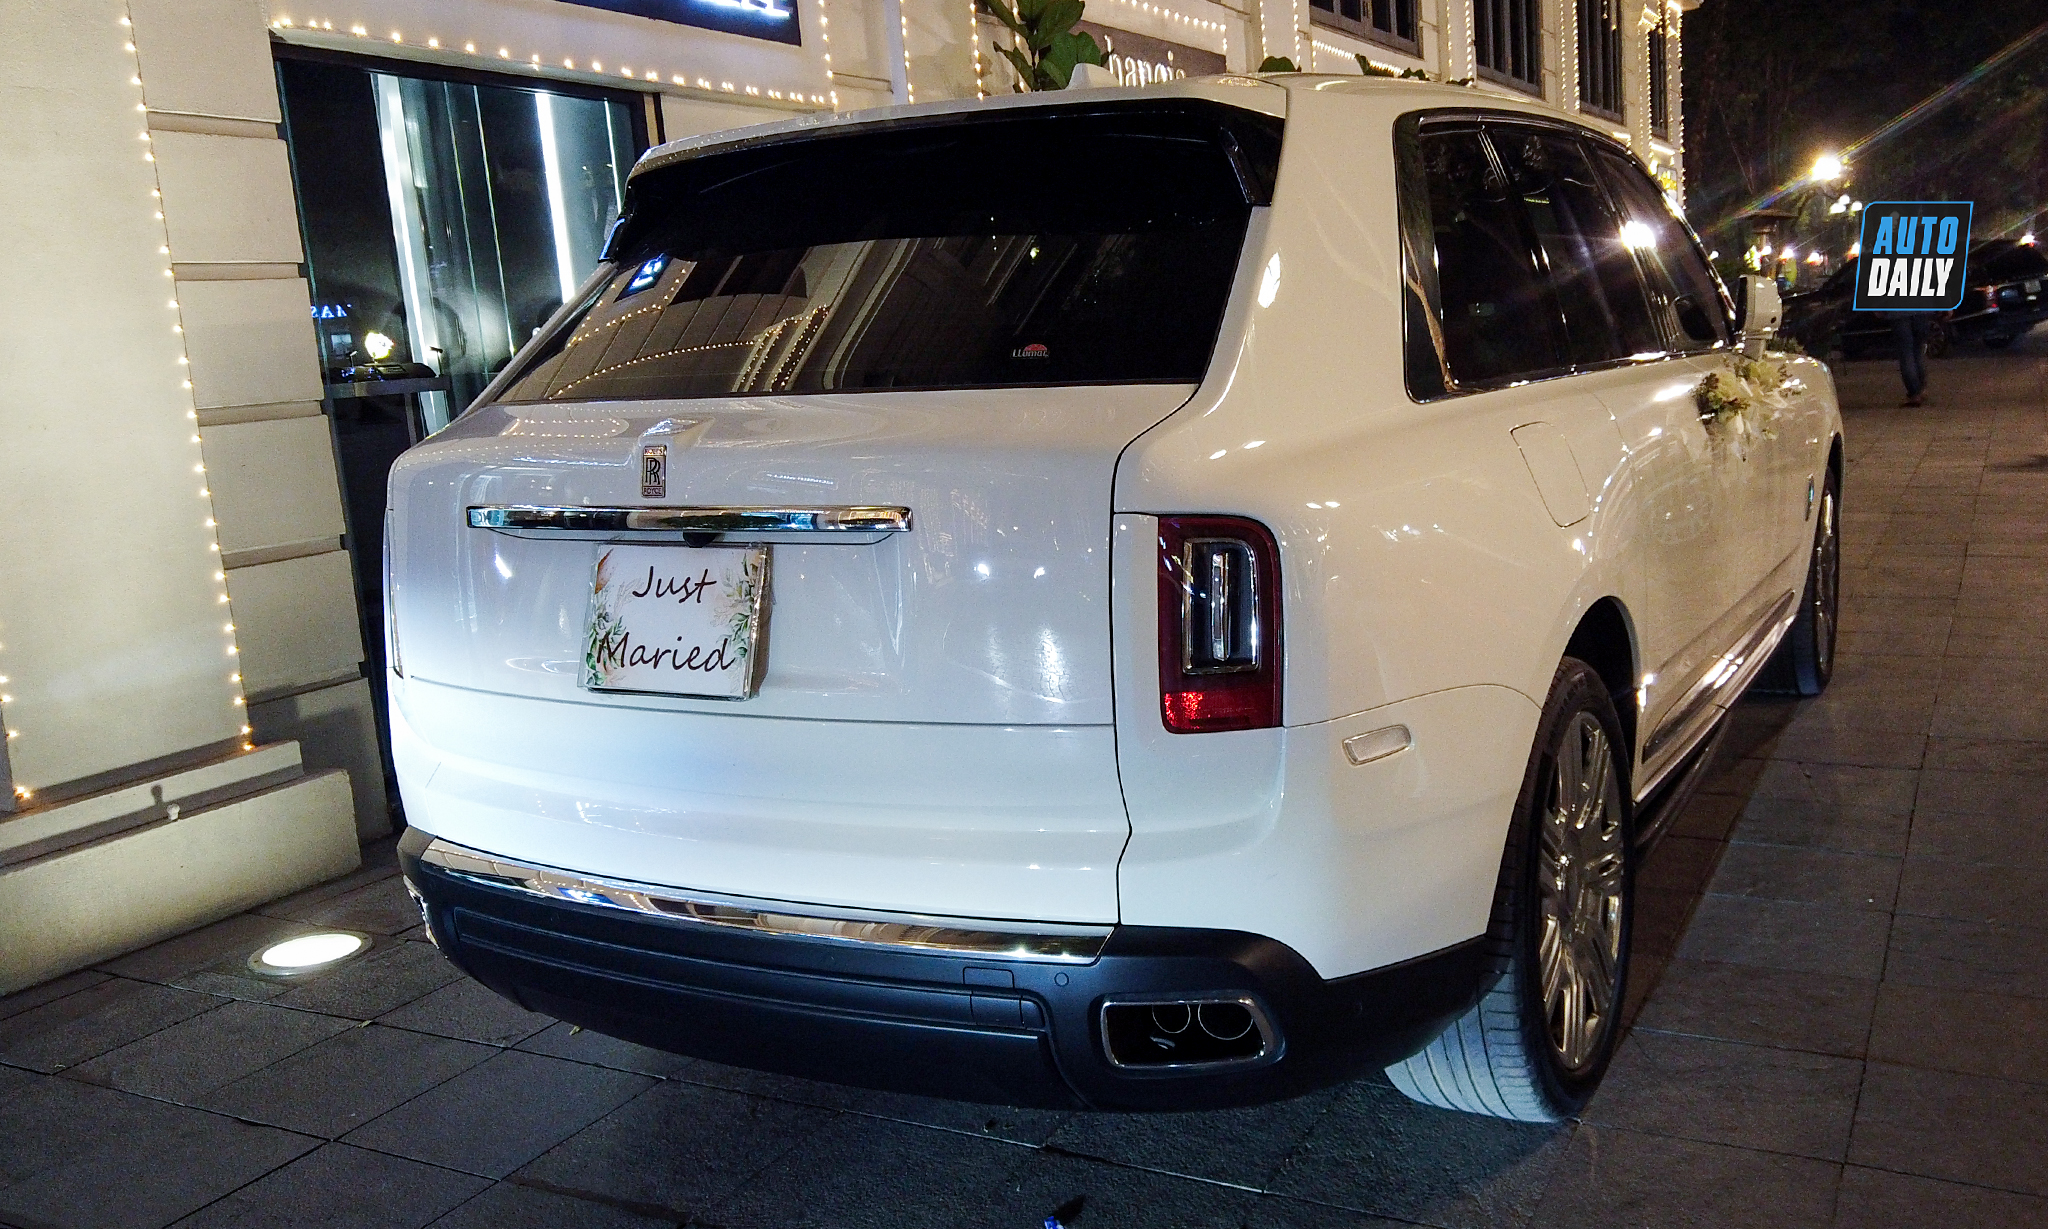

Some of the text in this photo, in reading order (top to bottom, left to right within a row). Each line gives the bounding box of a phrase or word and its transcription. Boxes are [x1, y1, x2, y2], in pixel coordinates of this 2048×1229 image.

[643, 487, 662, 495] ROYCE
[632, 565, 717, 603] Just
[596, 631, 736, 672] Maried
